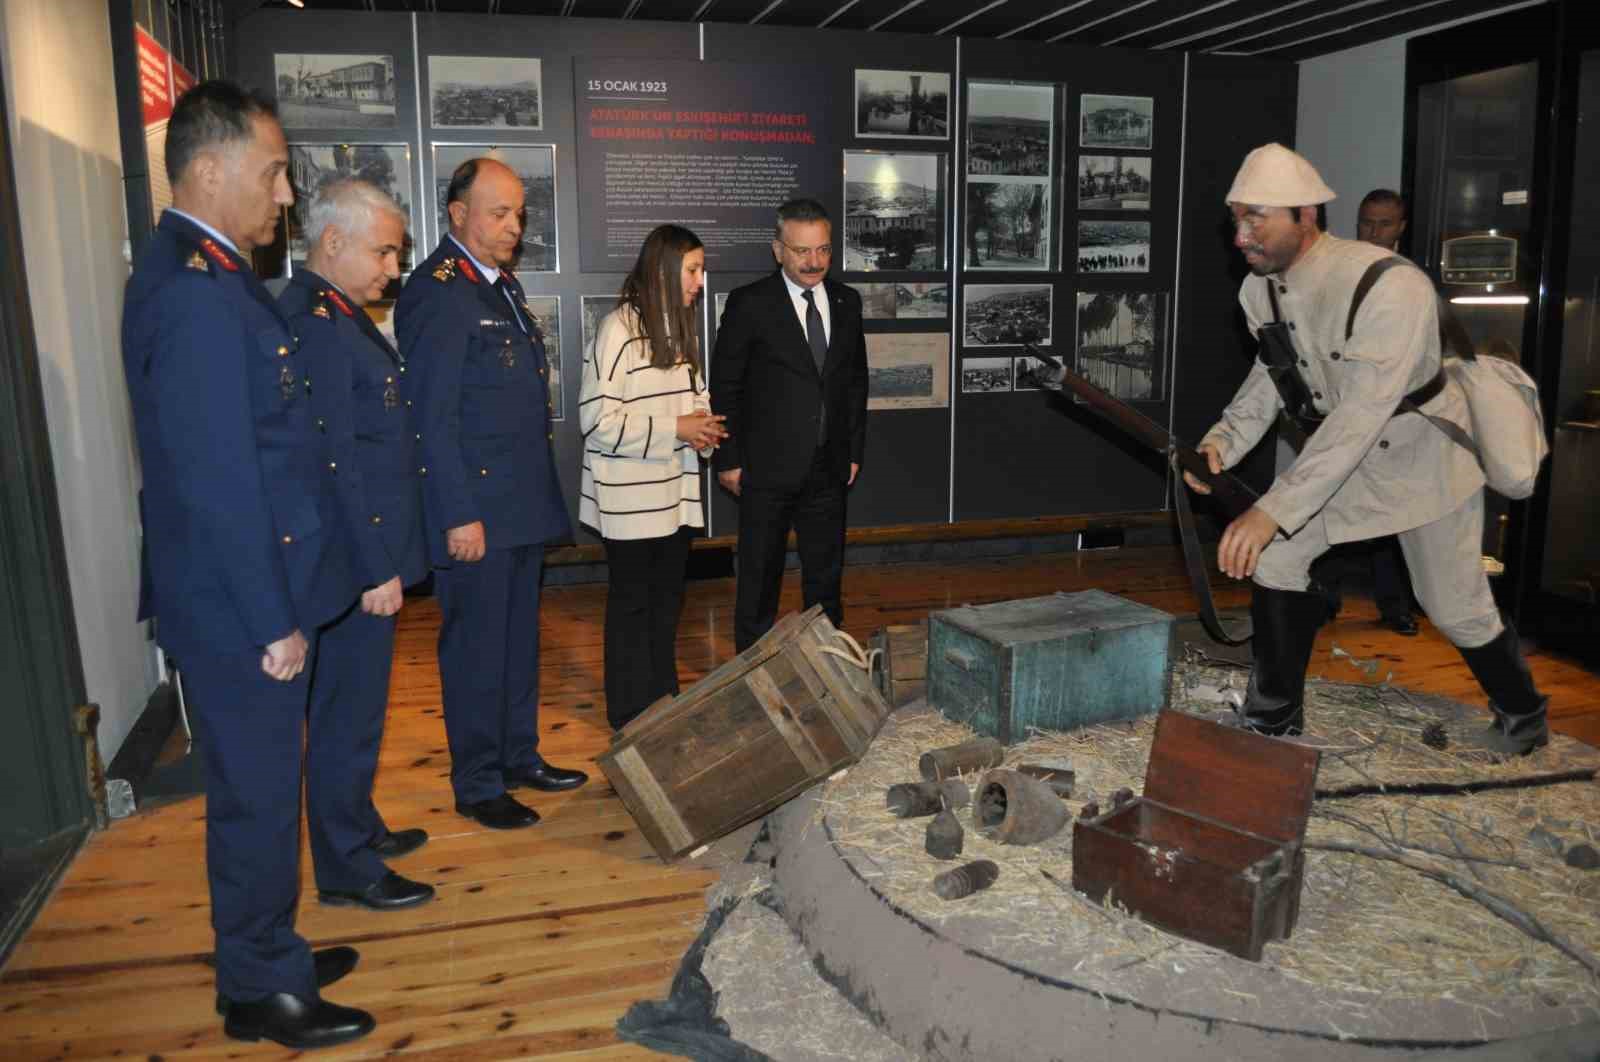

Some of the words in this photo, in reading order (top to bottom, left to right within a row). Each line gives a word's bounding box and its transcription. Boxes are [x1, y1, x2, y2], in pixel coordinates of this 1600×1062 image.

[587, 80, 601, 90] 15
[603, 80, 638, 92] OCAK
[639, 81, 668, 93] 1923
